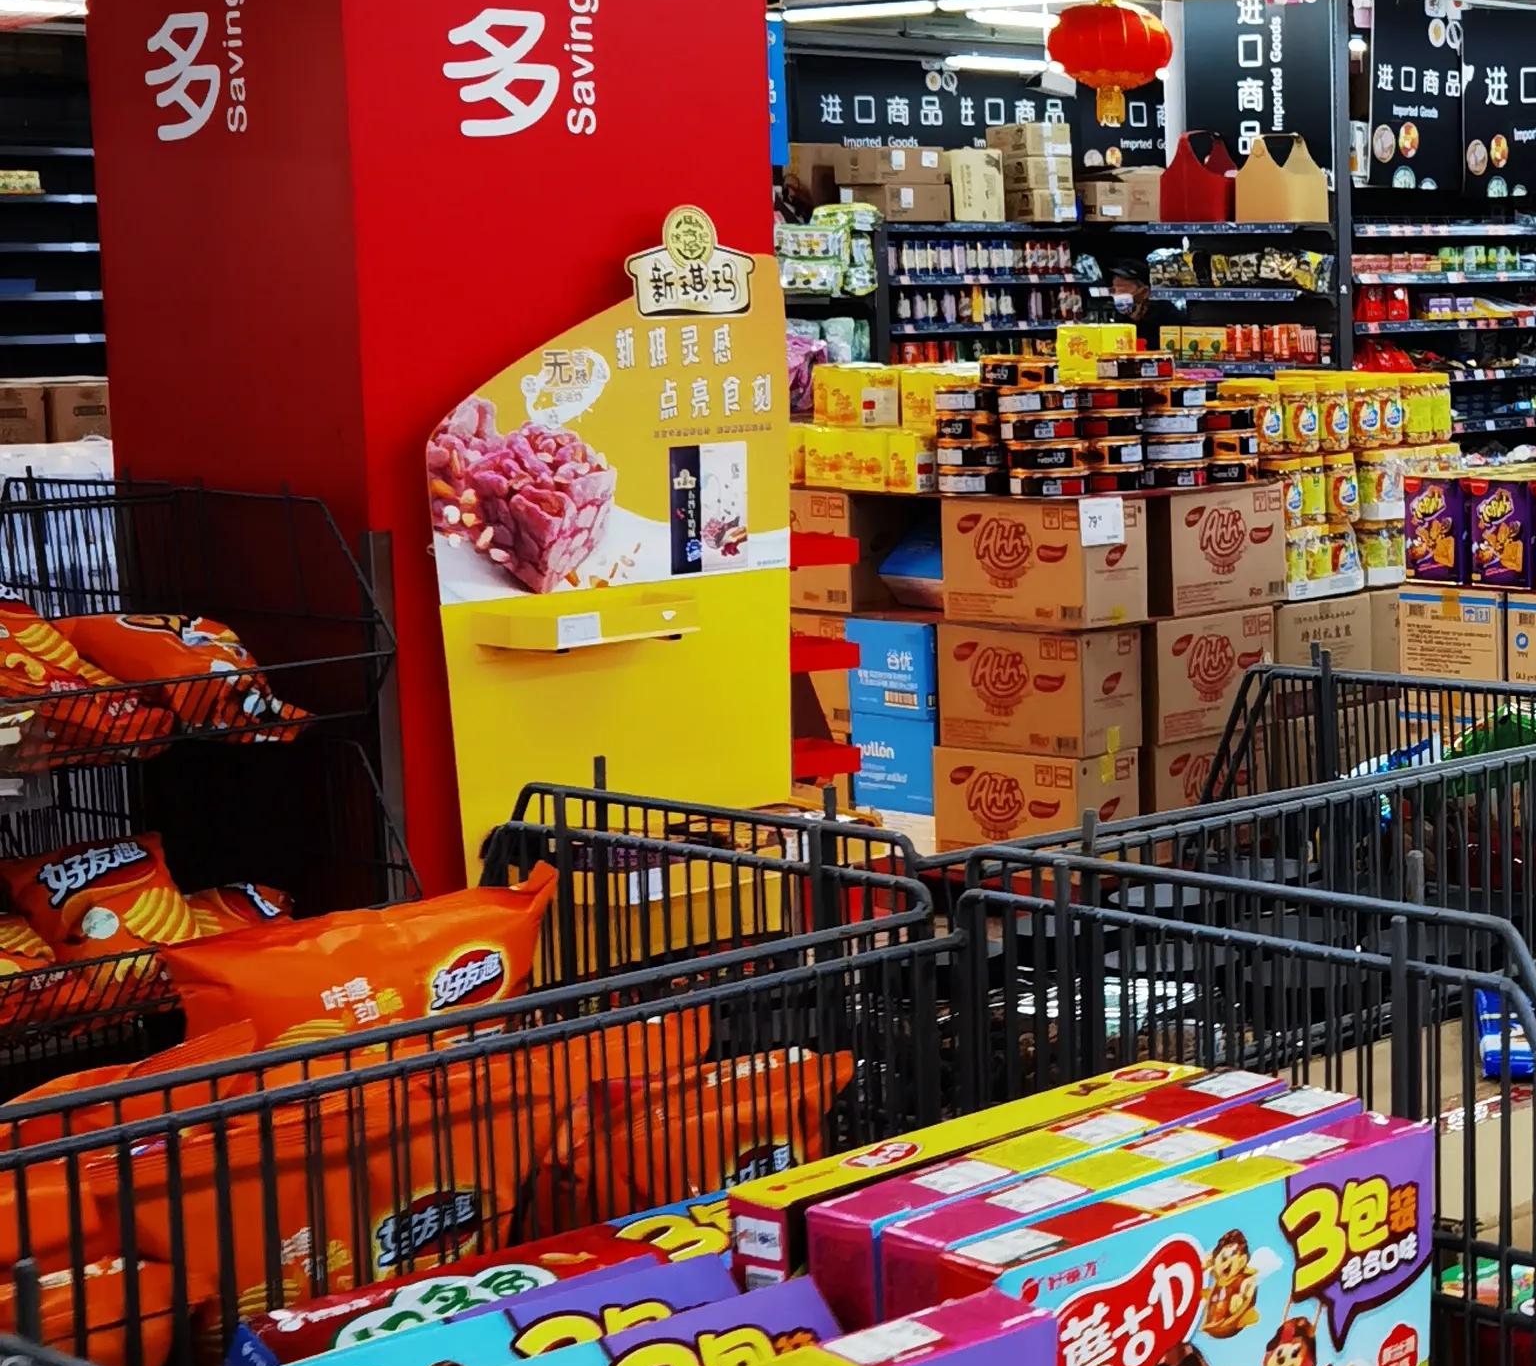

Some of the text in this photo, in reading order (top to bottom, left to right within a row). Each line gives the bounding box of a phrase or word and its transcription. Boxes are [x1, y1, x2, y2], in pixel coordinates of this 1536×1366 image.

[1269, 16, 1284, 131] Imported Goods
[1377, 64, 1460, 98] 进口商品
[821, 95, 943, 125] 进口商品
[659, 374, 772, 421] 点亮食刻
[39, 841, 148, 908] 好友趣
[431, 952, 502, 1010] 好友趣
